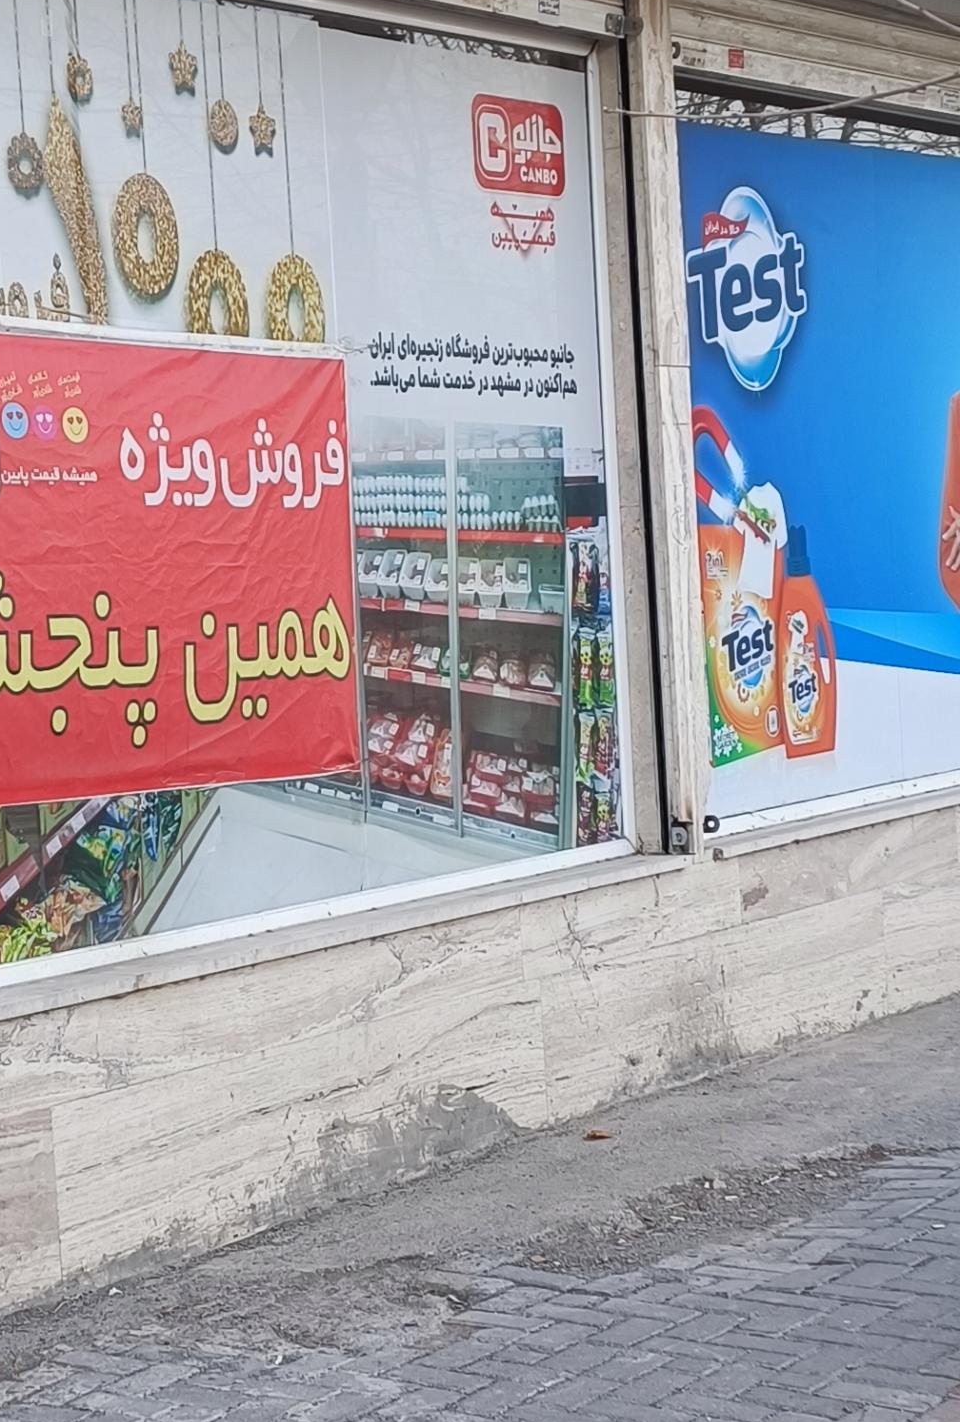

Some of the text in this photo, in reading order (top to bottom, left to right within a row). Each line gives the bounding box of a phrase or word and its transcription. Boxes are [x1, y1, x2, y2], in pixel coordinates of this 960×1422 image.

[520, 165, 559, 186] CANBO
[687, 235, 806, 339] Test
[370, 331, 394, 359] ایران
[445, 333, 490, 365] فروشگاه
[550, 343, 575, 369] جانبو
[417, 365, 440, 389] شما
[443, 369, 476, 391] خدمت
[477, 376, 489, 397] در
[490, 371, 521, 397] مشهد
[523, 377, 534, 398] در
[118, 410, 346, 510] فروش ویژه
[0, 464, 99, 488] همیشه قیمت پایین
[722, 619, 775, 672] Test
[182, 594, 353, 725] همین
[788, 670, 817, 705] Test
